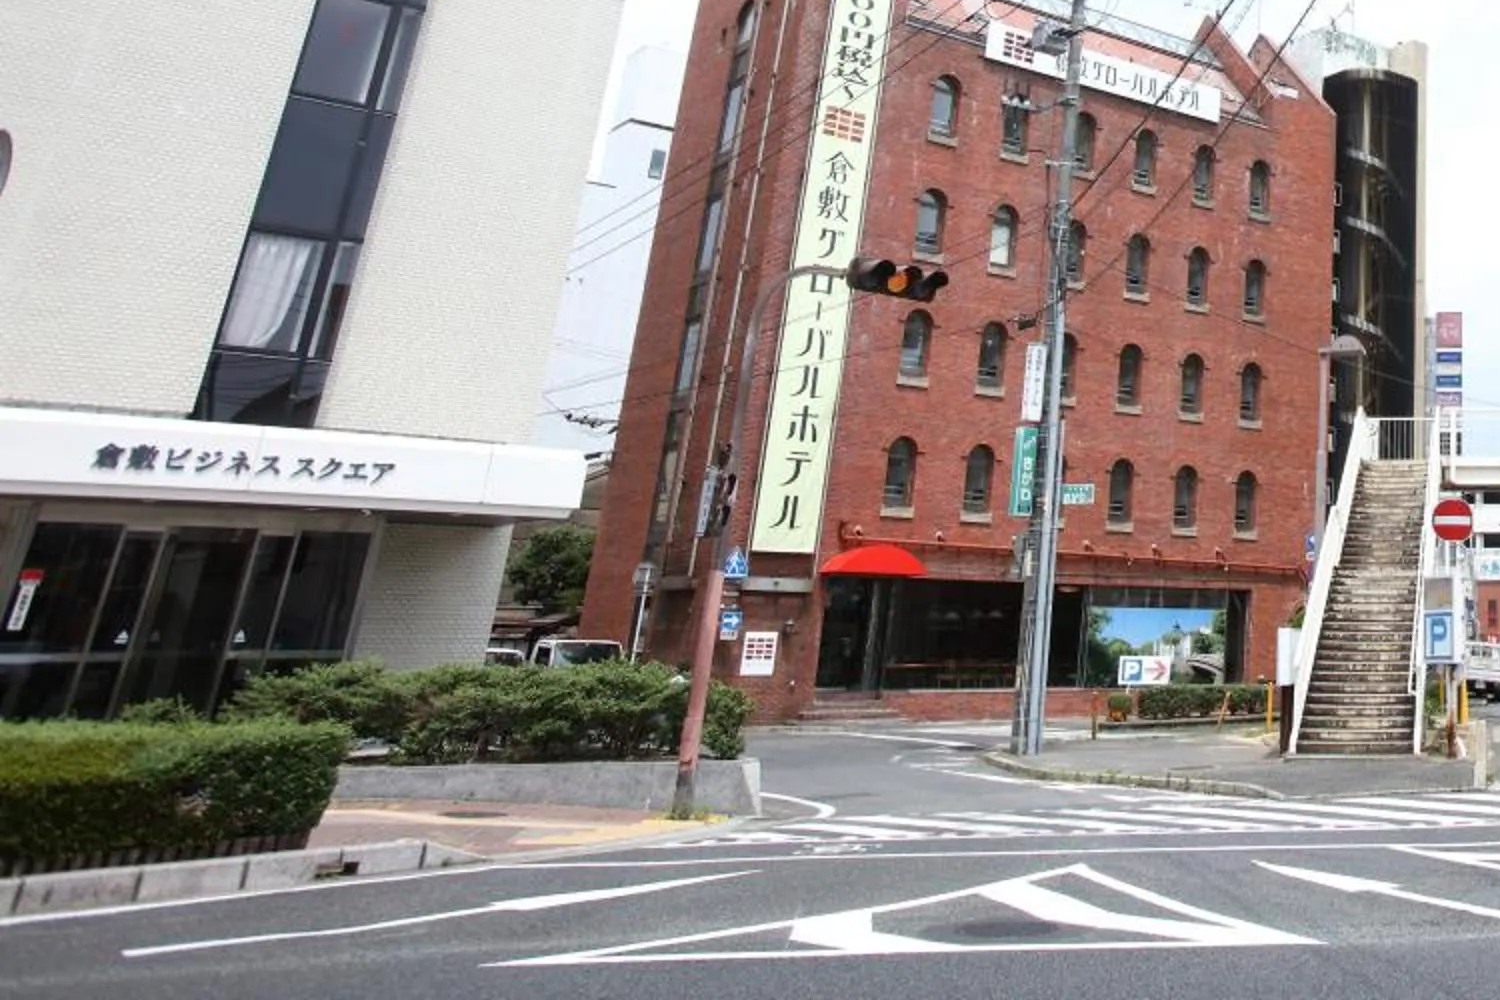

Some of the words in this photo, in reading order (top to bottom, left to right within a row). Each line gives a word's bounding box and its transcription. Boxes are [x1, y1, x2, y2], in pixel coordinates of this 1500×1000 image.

[769, 151, 856, 530] 倉敷グローバルホテル
[1431, 617, 1447, 655] P
[1124, 661, 1140, 680] P
